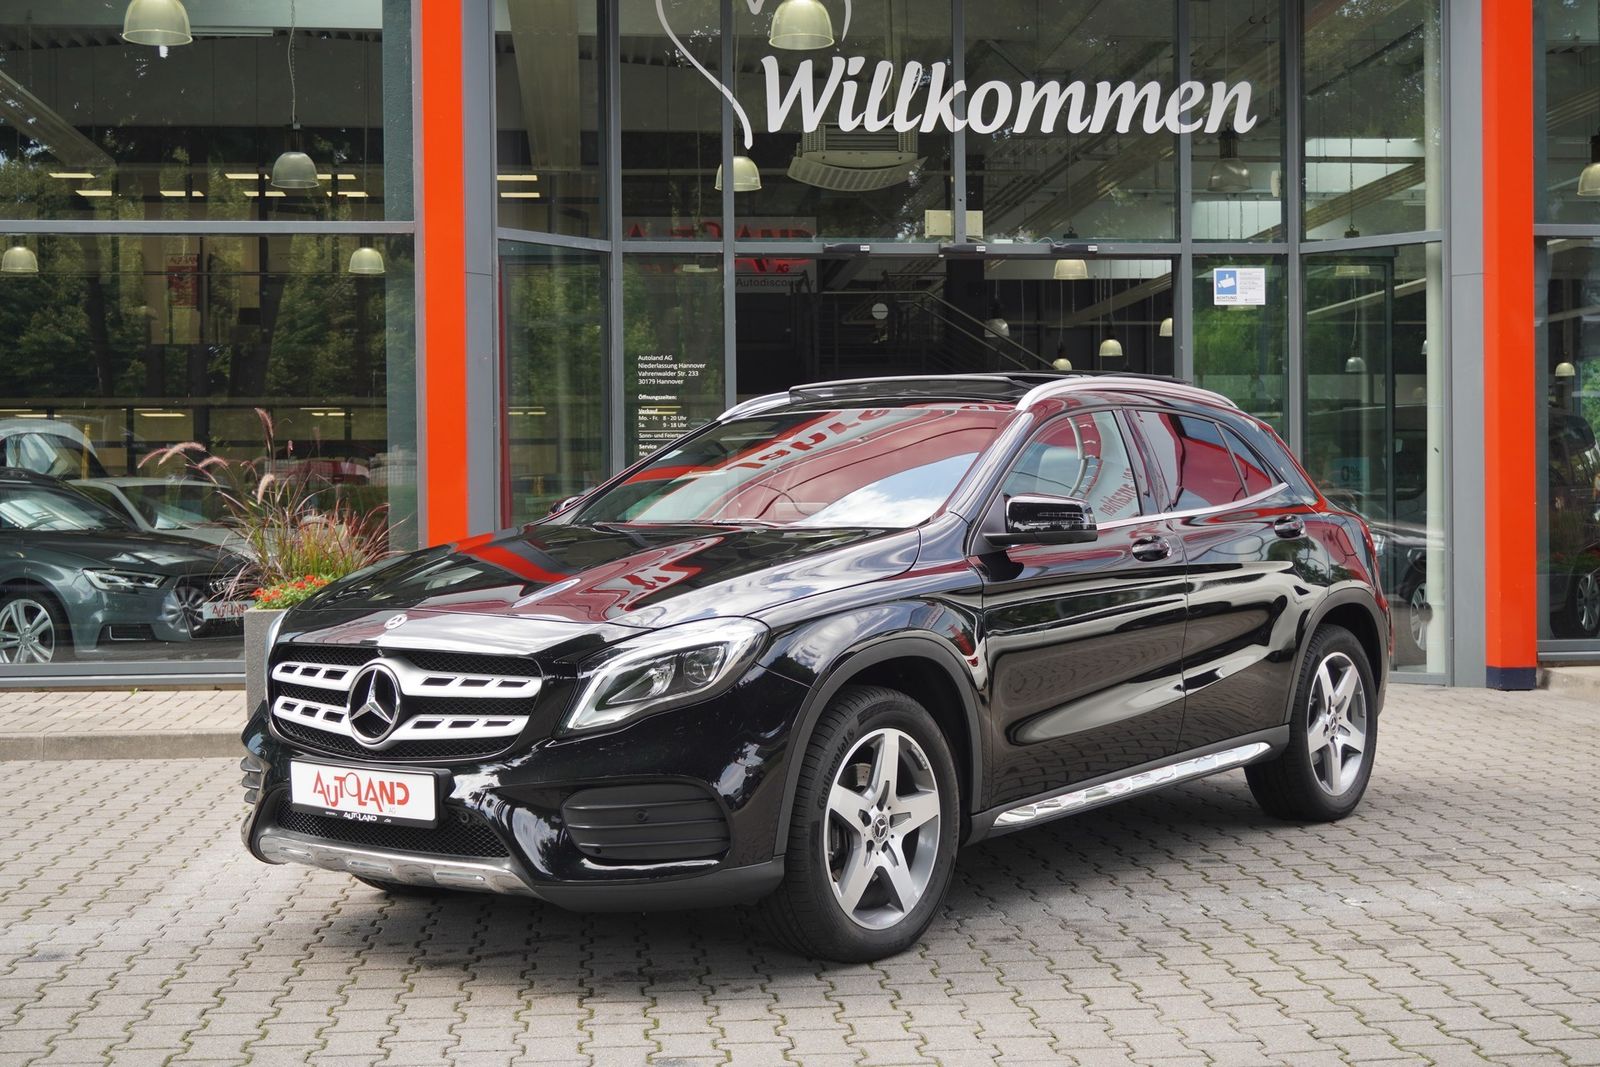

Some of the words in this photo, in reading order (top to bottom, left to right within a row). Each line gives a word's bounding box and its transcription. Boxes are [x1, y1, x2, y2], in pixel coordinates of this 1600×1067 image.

[760, 55, 1257, 135] Willkommen
[776, 264, 789, 273] AG
[736, 278, 814, 288] Autodiscor
[313, 769, 410, 812] AUTOLAND
